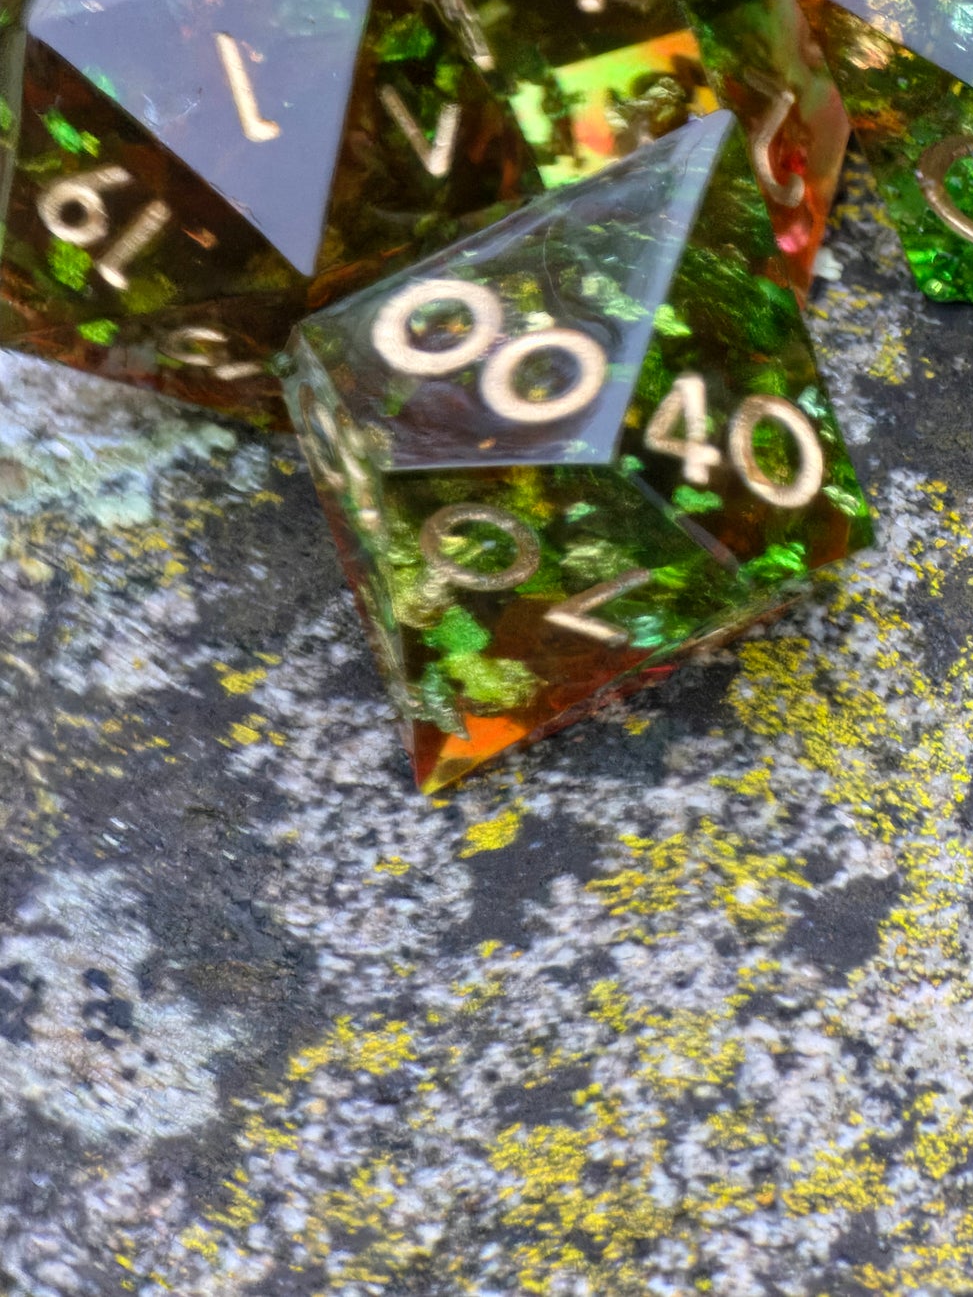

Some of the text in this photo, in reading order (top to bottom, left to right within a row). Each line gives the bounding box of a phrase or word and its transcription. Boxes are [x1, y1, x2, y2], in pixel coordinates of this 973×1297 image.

[213, 31, 282, 142] 1
[371, 278, 610, 424] 00
[642, 370, 826, 510] 40
